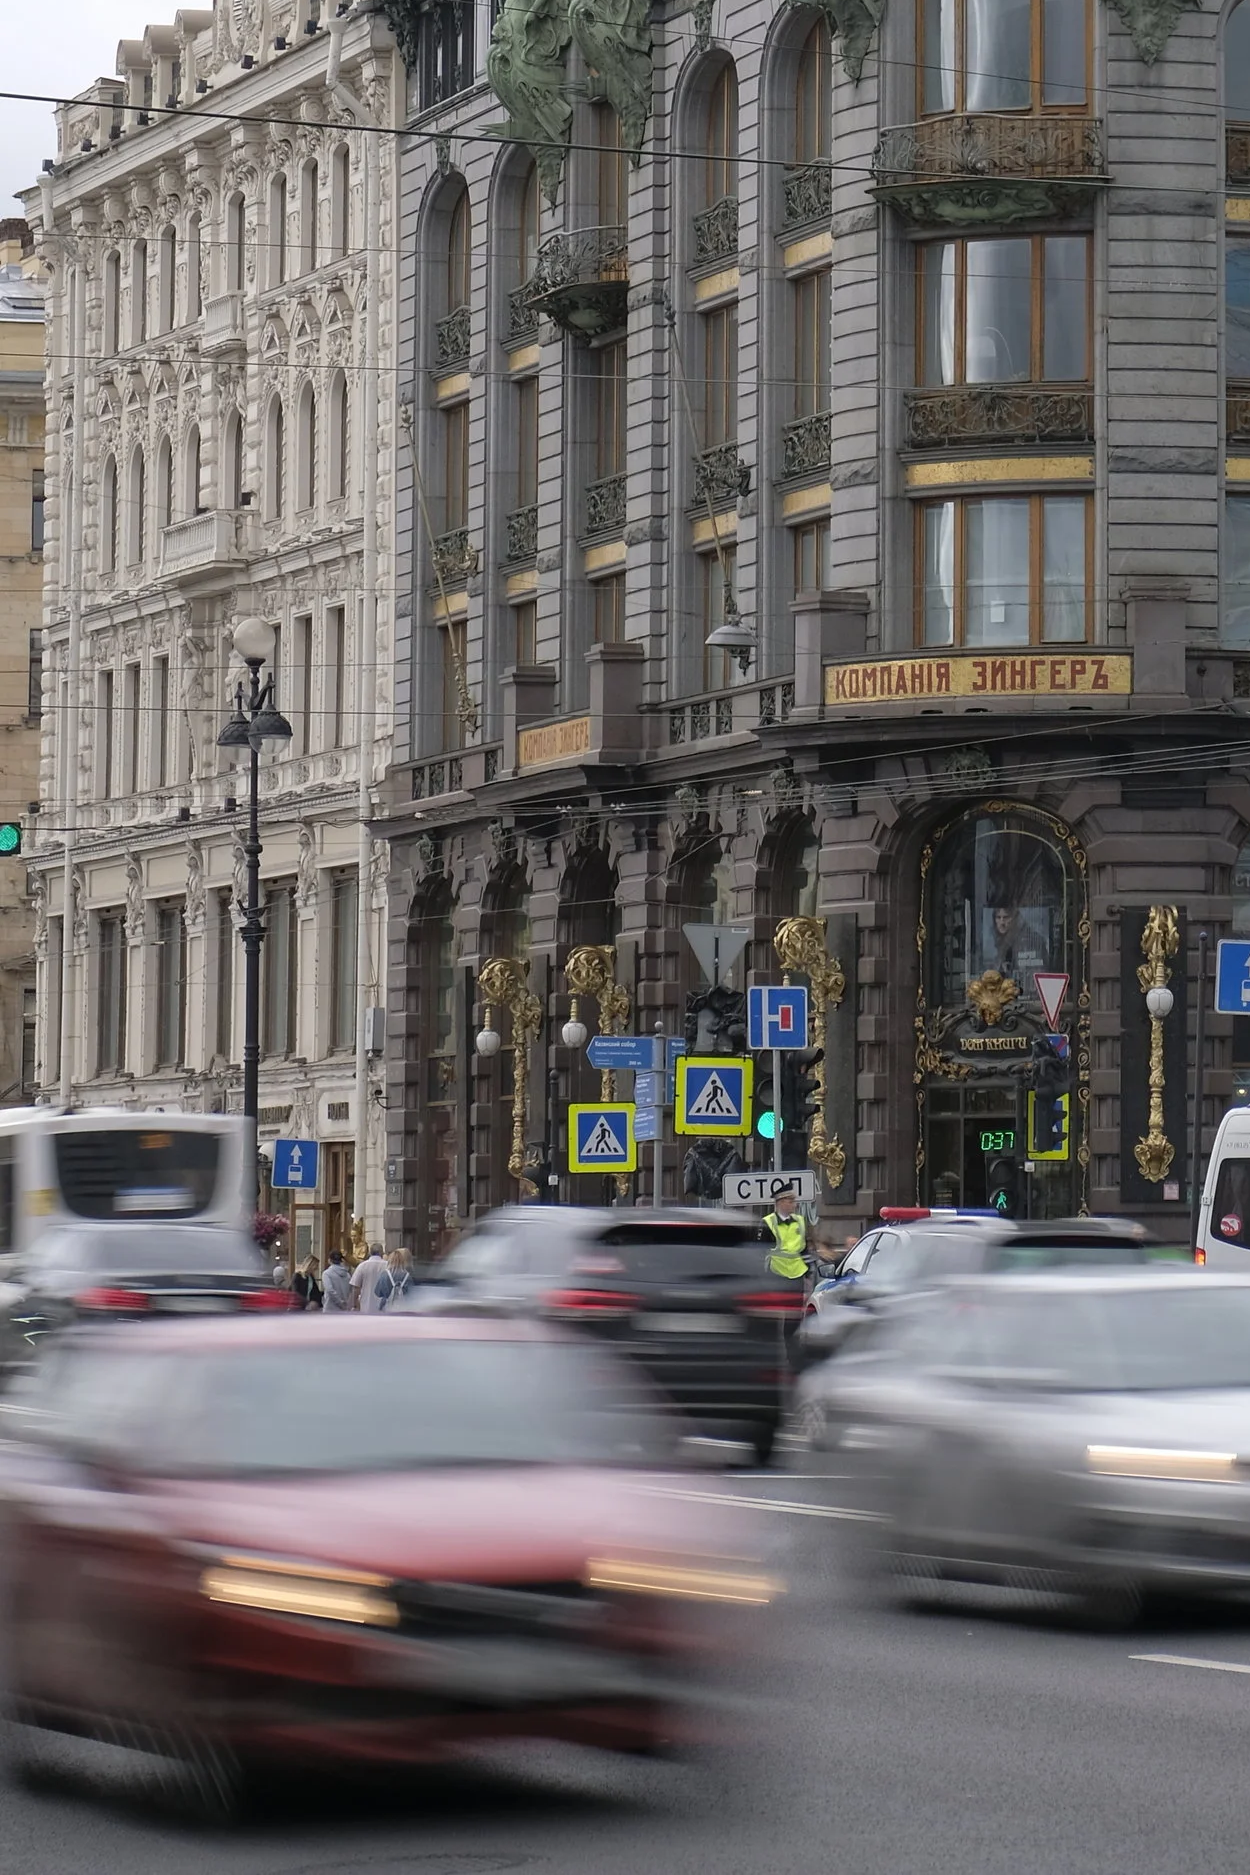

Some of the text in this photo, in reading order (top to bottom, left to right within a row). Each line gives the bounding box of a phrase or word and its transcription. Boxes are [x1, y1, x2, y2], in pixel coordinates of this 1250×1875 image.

[836, 660, 1109, 699] КОМПАНІЯ ЗИНГЕРЪ
[981, 1131, 1014, 1151] 0:37
[737, 1177, 802, 1200] СТОП
